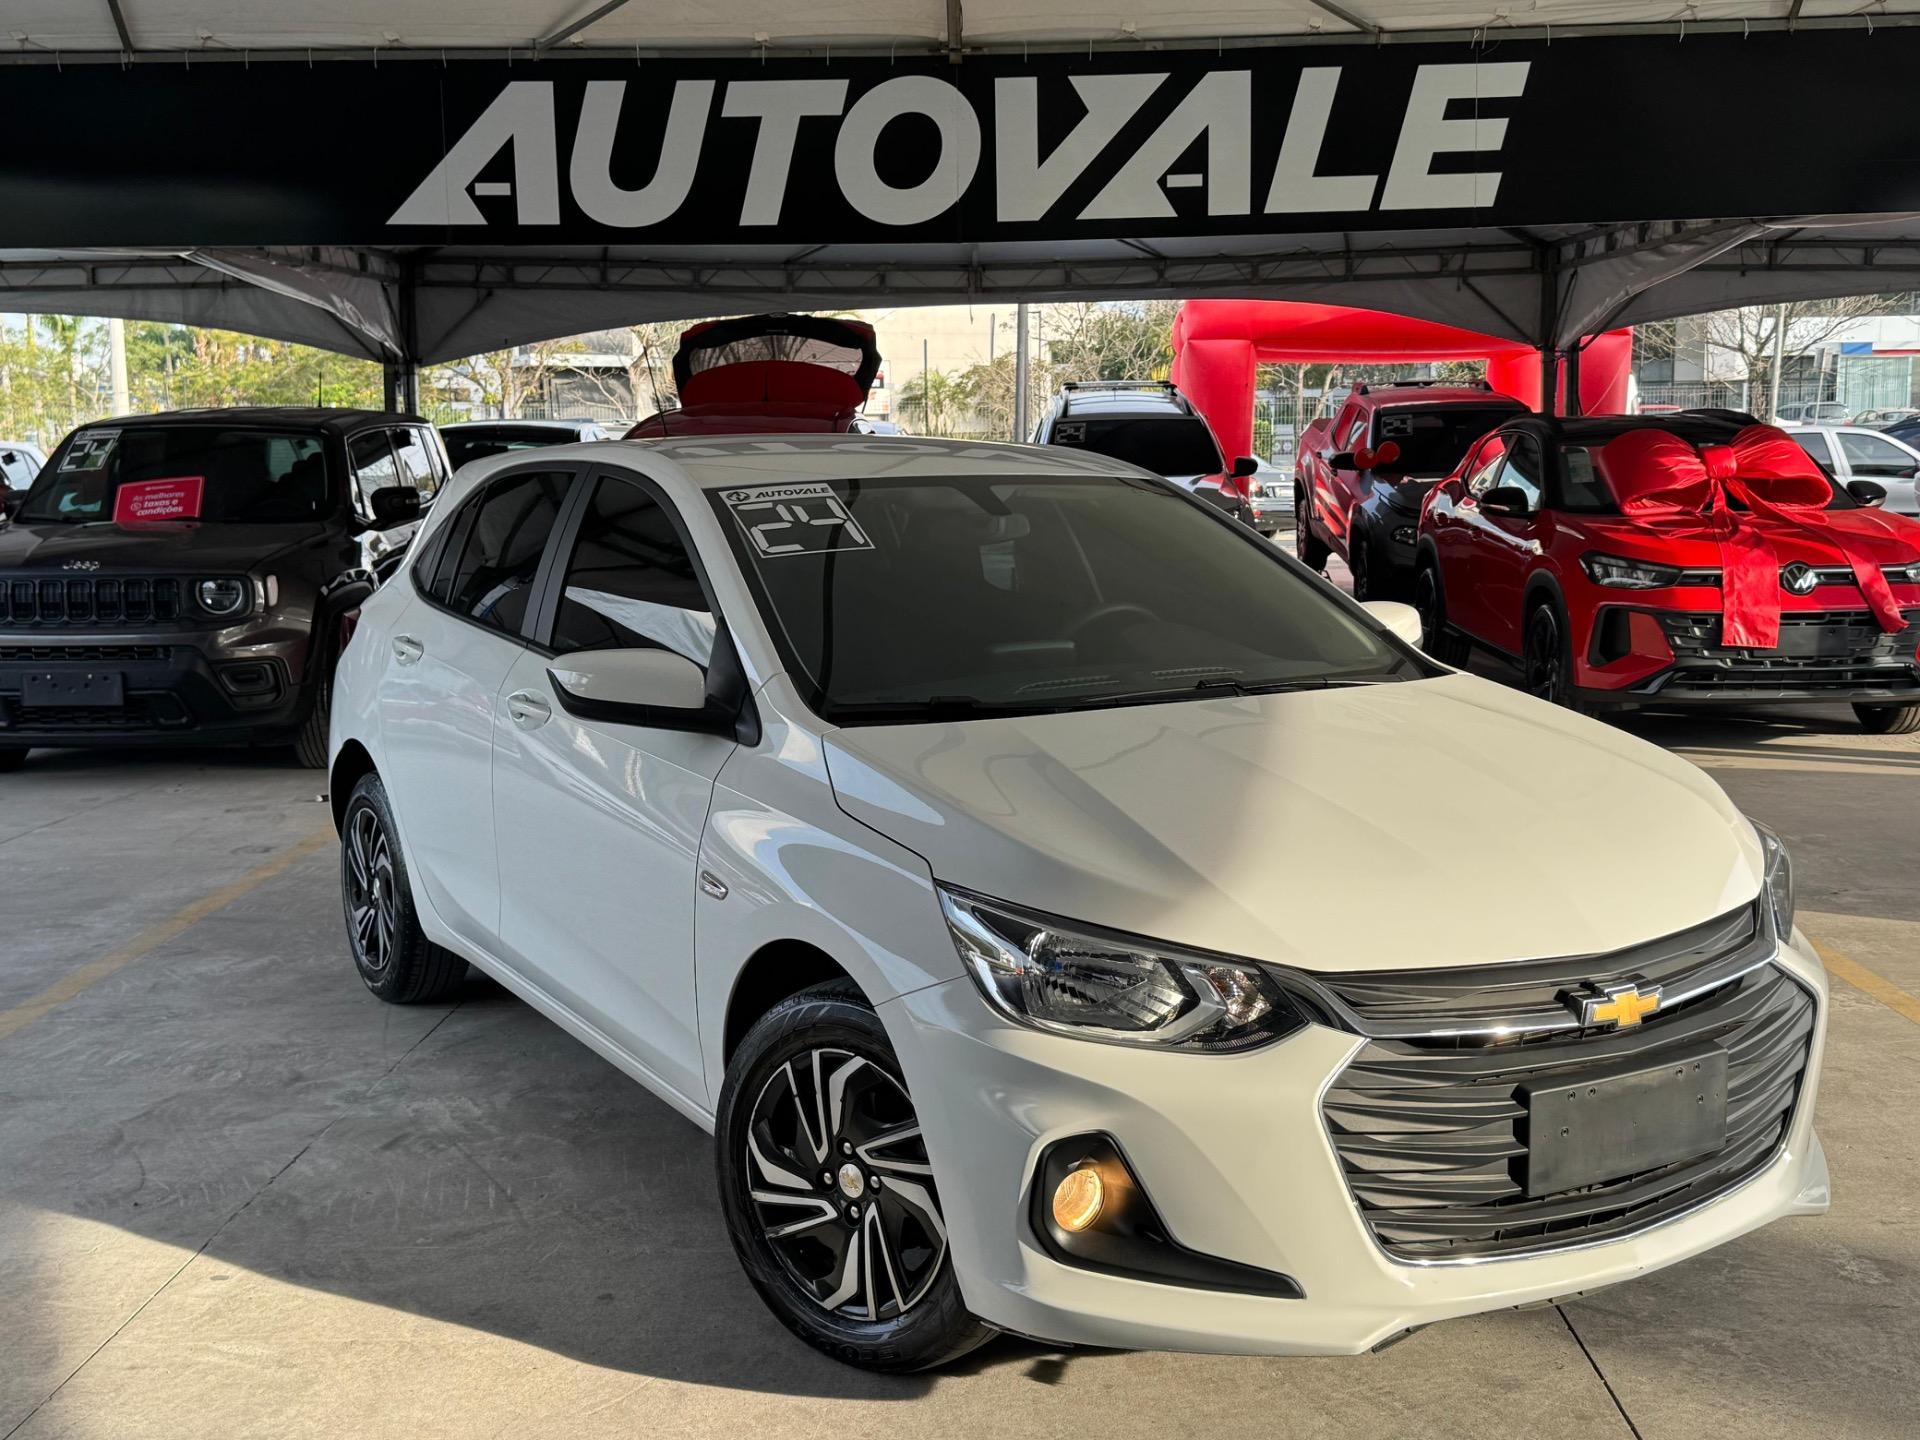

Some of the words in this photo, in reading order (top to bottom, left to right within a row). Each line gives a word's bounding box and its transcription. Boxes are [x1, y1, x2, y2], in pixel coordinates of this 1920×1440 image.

[386, 61, 1531, 227] AUTOVALE
[61, 438, 114, 470] 24
[754, 486, 830, 499] AUTOVALE
[736, 498, 865, 553] 24
